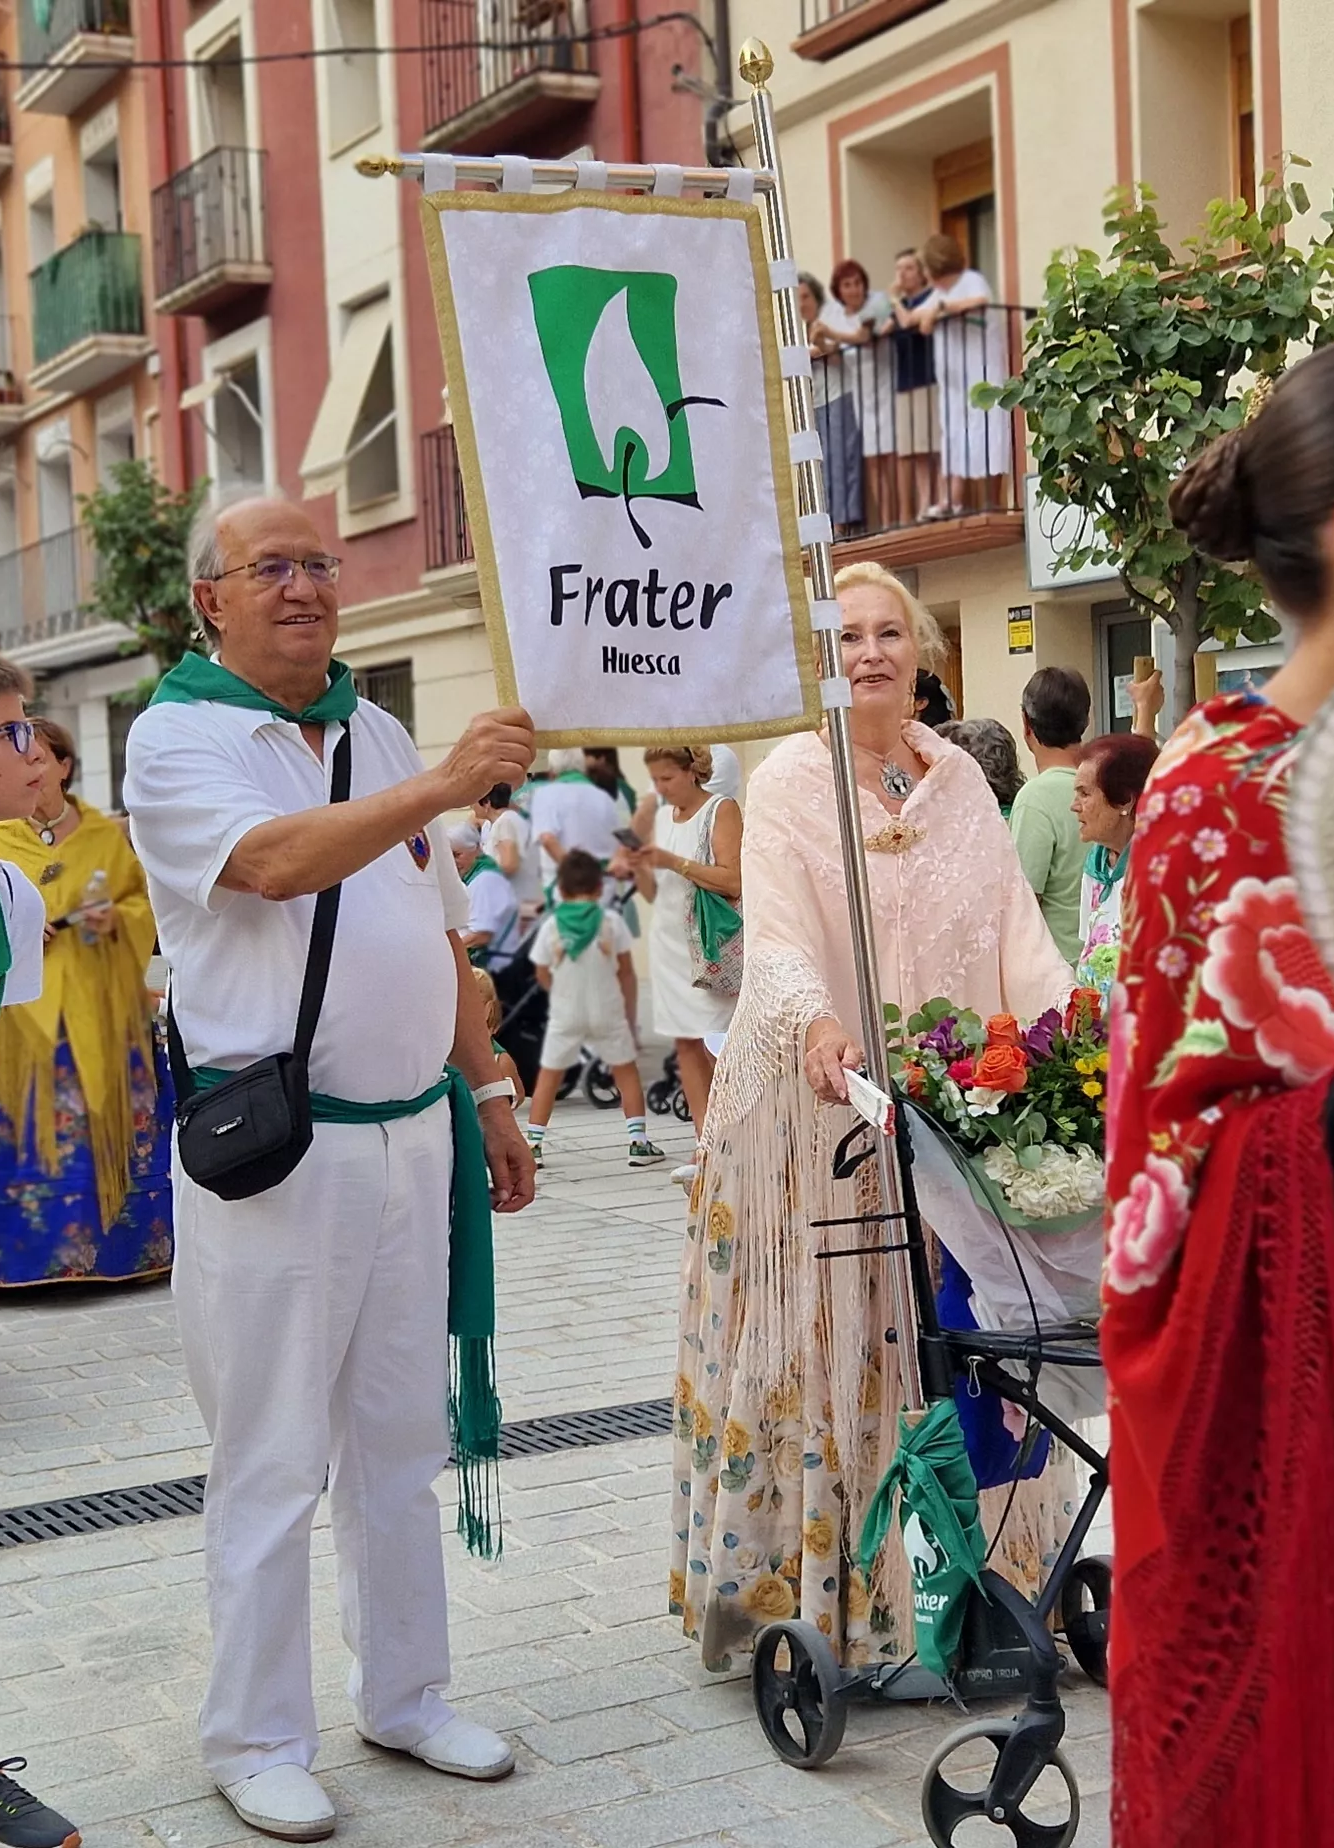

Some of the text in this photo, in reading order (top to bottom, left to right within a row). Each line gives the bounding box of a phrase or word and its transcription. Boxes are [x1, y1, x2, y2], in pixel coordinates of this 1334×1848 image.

[549, 563, 733, 631] Frater
[601, 645, 681, 675] Huesca
[914, 1590, 949, 1612] ater
